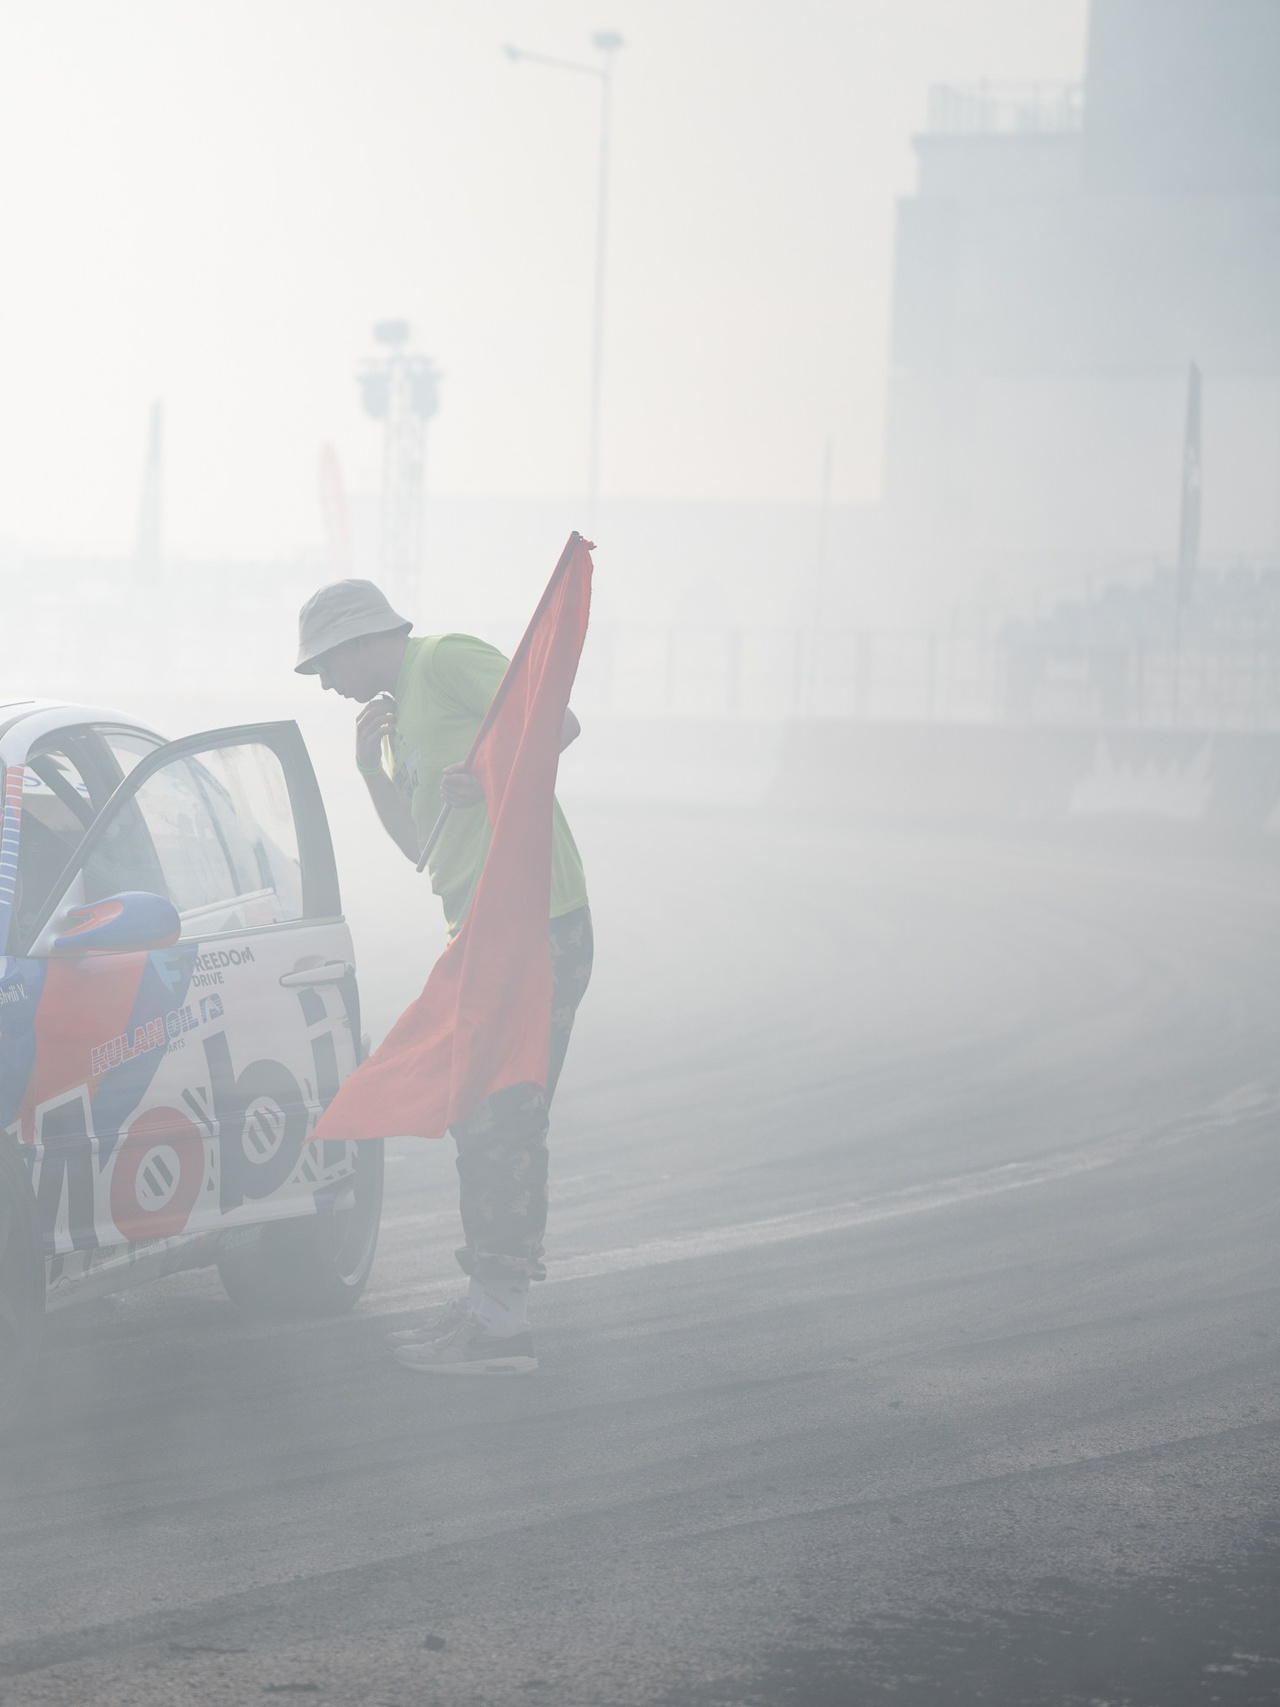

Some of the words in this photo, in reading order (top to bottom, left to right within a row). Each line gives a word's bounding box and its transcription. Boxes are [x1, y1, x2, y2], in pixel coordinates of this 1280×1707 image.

[191, 971, 225, 988] DRIVE
[91, 1017, 166, 1076] KULAN
[166, 1004, 200, 1040] OIL
